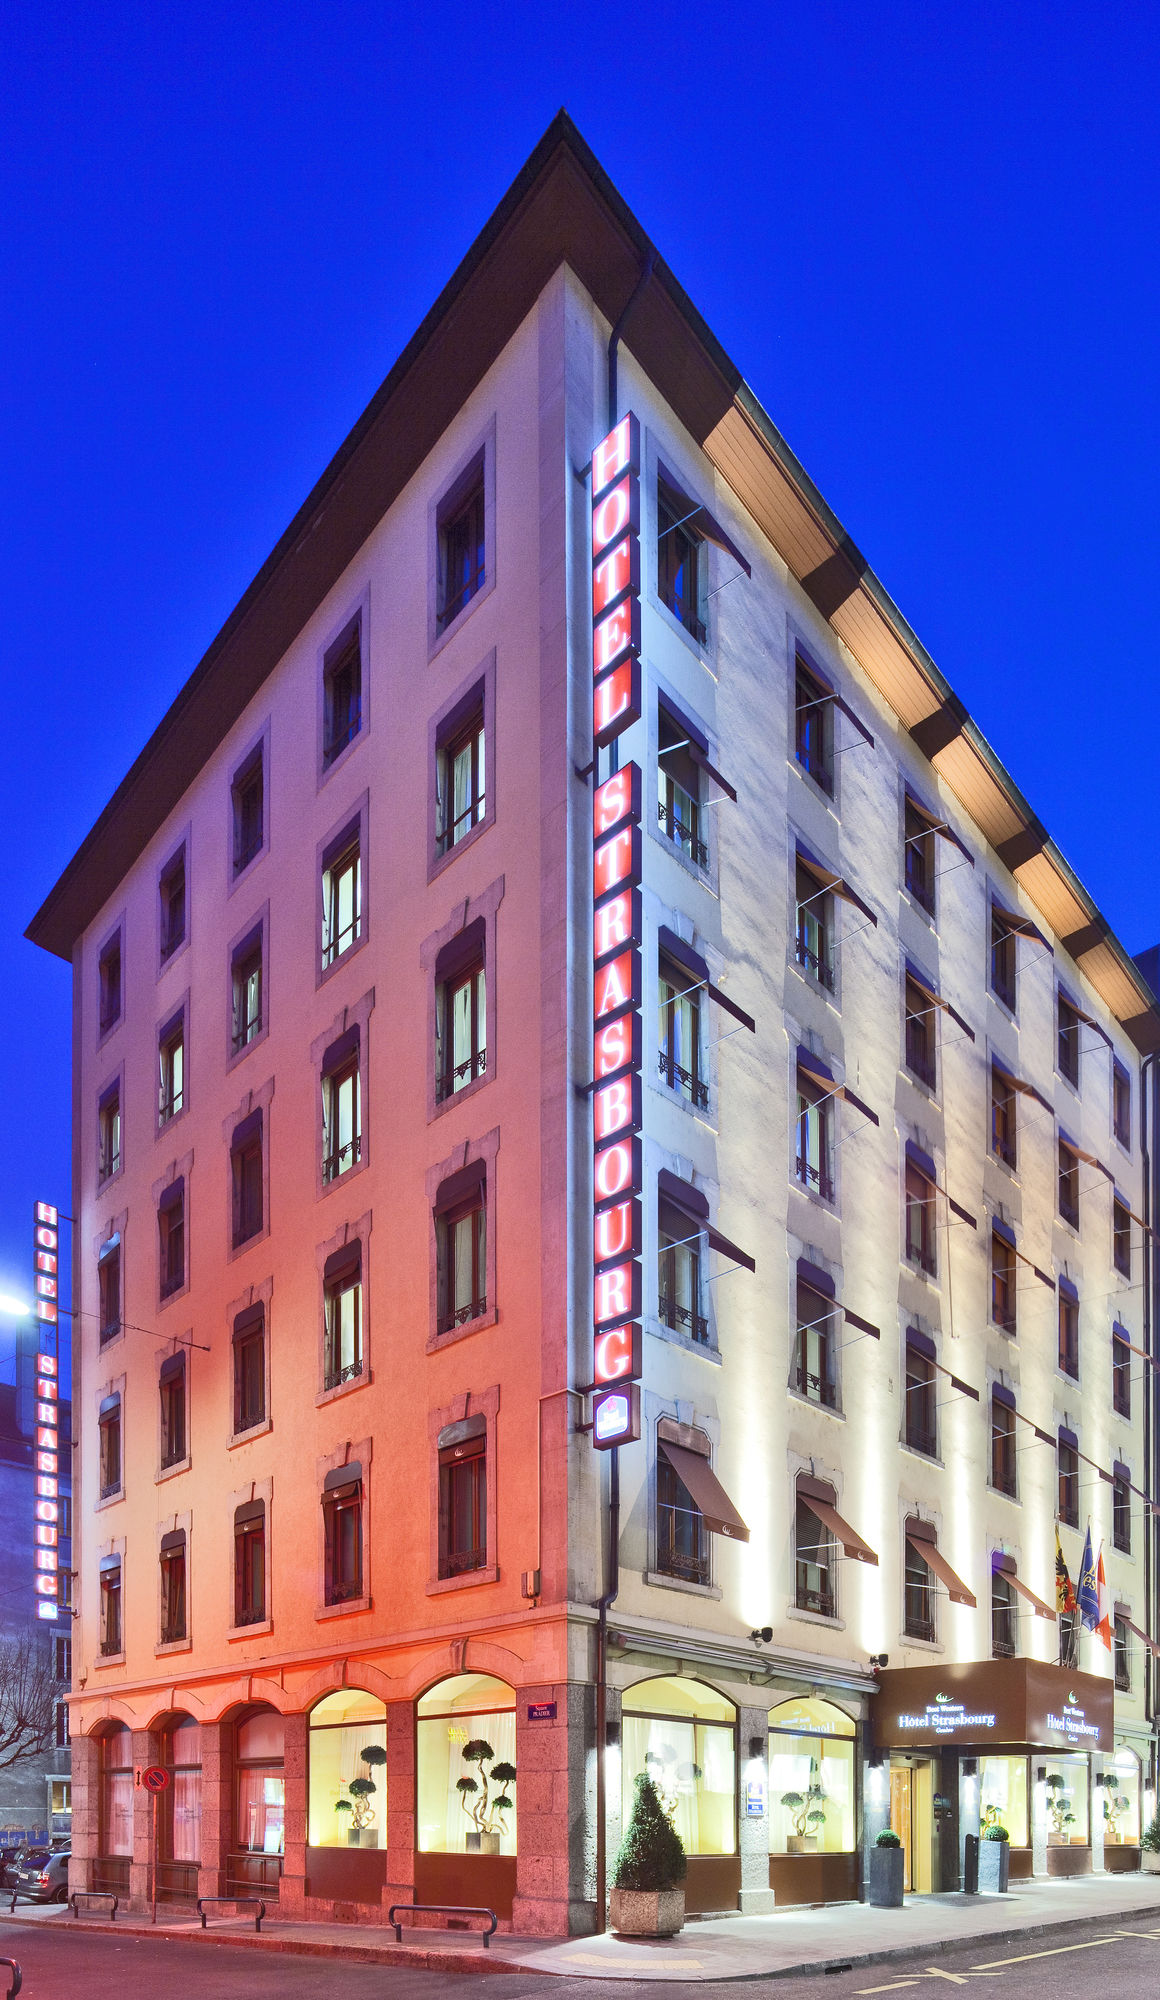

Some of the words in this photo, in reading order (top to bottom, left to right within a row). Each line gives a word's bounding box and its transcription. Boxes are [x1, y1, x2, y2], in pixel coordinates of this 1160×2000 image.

[593, 416, 630, 731] HOTEL
[596, 772, 631, 1380] STRASBOURG
[38, 1202, 57, 1322] HOTEL
[37, 1355, 57, 1594] STRASBOURG
[931, 1713, 995, 1727] Strasbourg
[1065, 1717, 1099, 1740] Strasbourg
